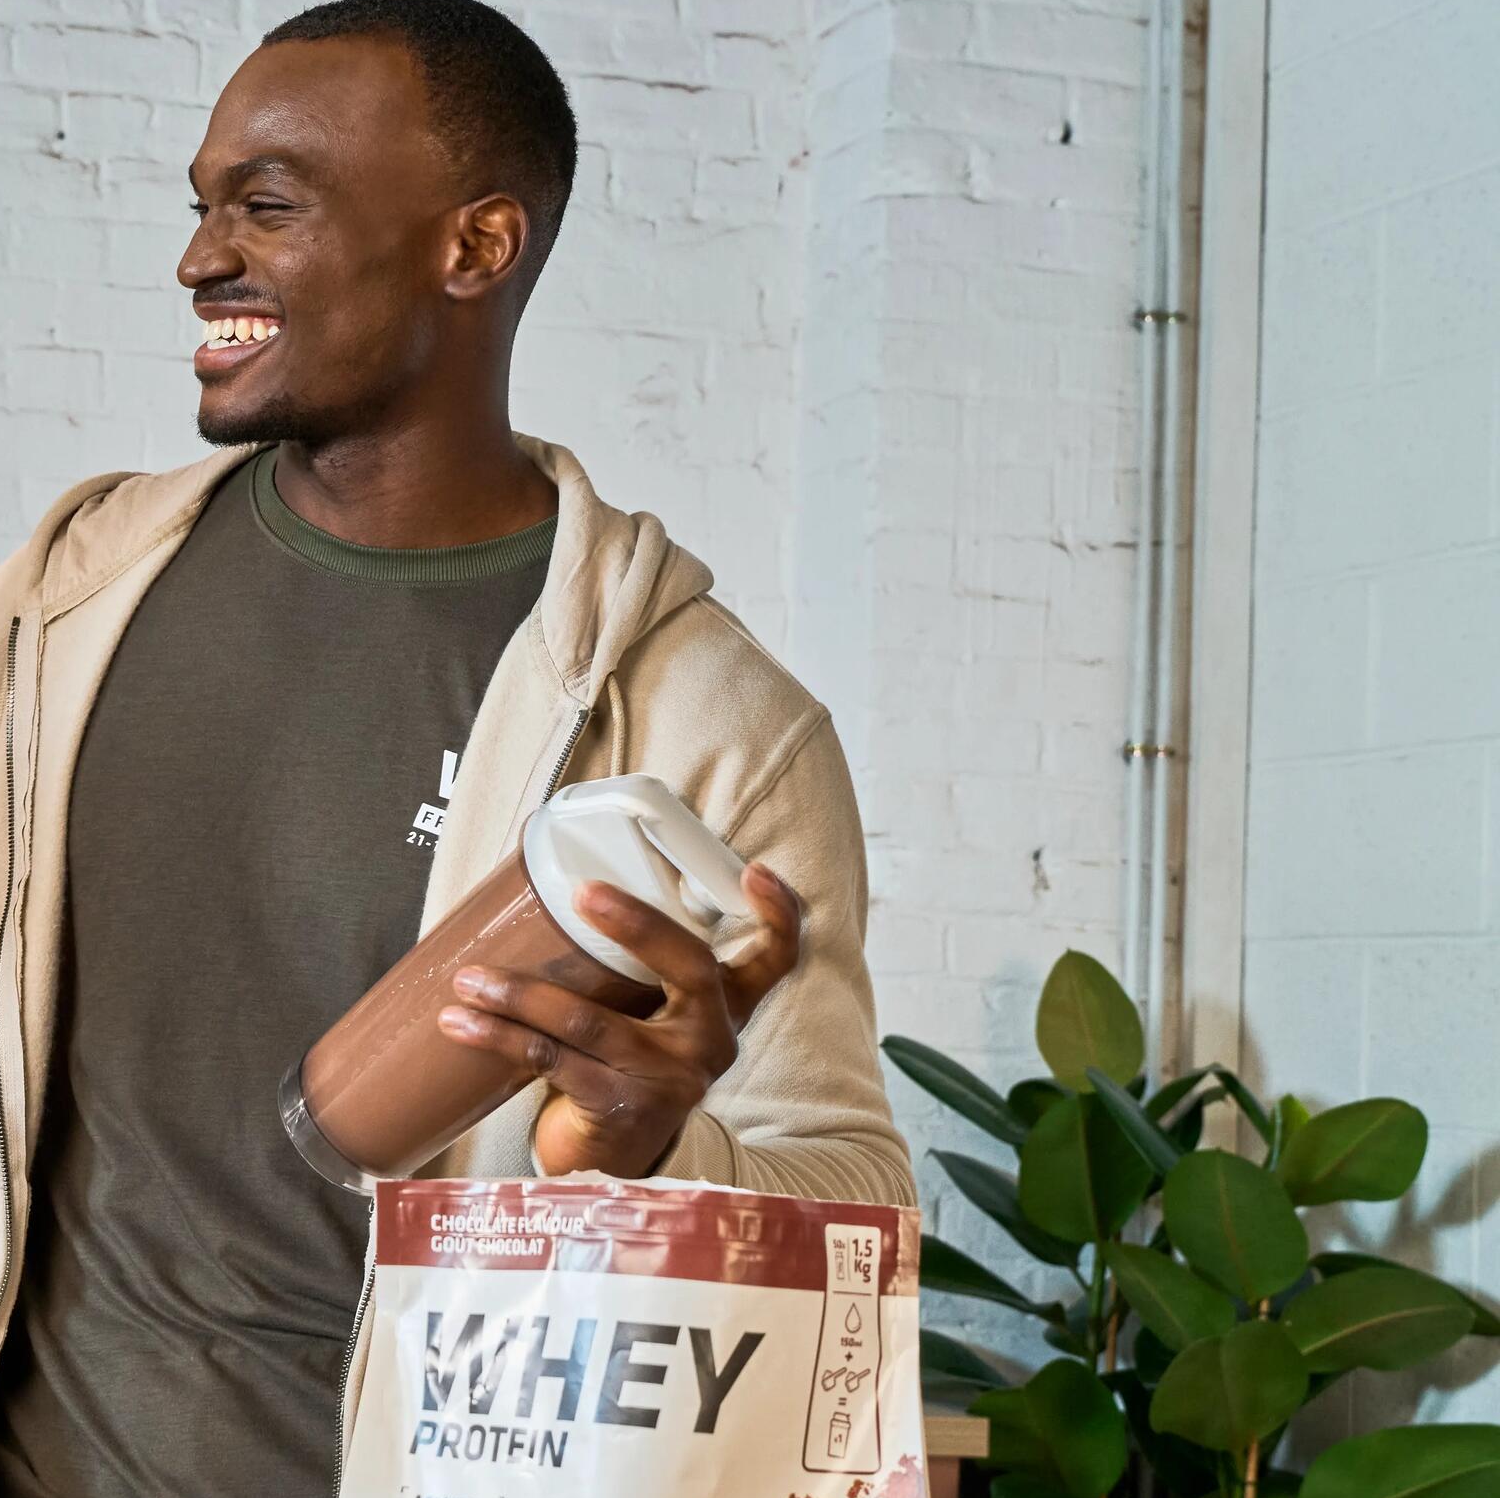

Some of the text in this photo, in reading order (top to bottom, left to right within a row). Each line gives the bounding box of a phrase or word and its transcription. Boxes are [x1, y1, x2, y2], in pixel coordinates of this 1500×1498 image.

[430, 1213, 585, 1235] CHOCOLATE FLAVOUR
[430, 1233, 546, 1256] GOÛT CHOCOLAT
[852, 1238, 873, 1257] 1.5
[854, 1259, 872, 1283] Kg
[421, 1311, 767, 1434] WHEY
[409, 1419, 569, 1468] PROTEIN
